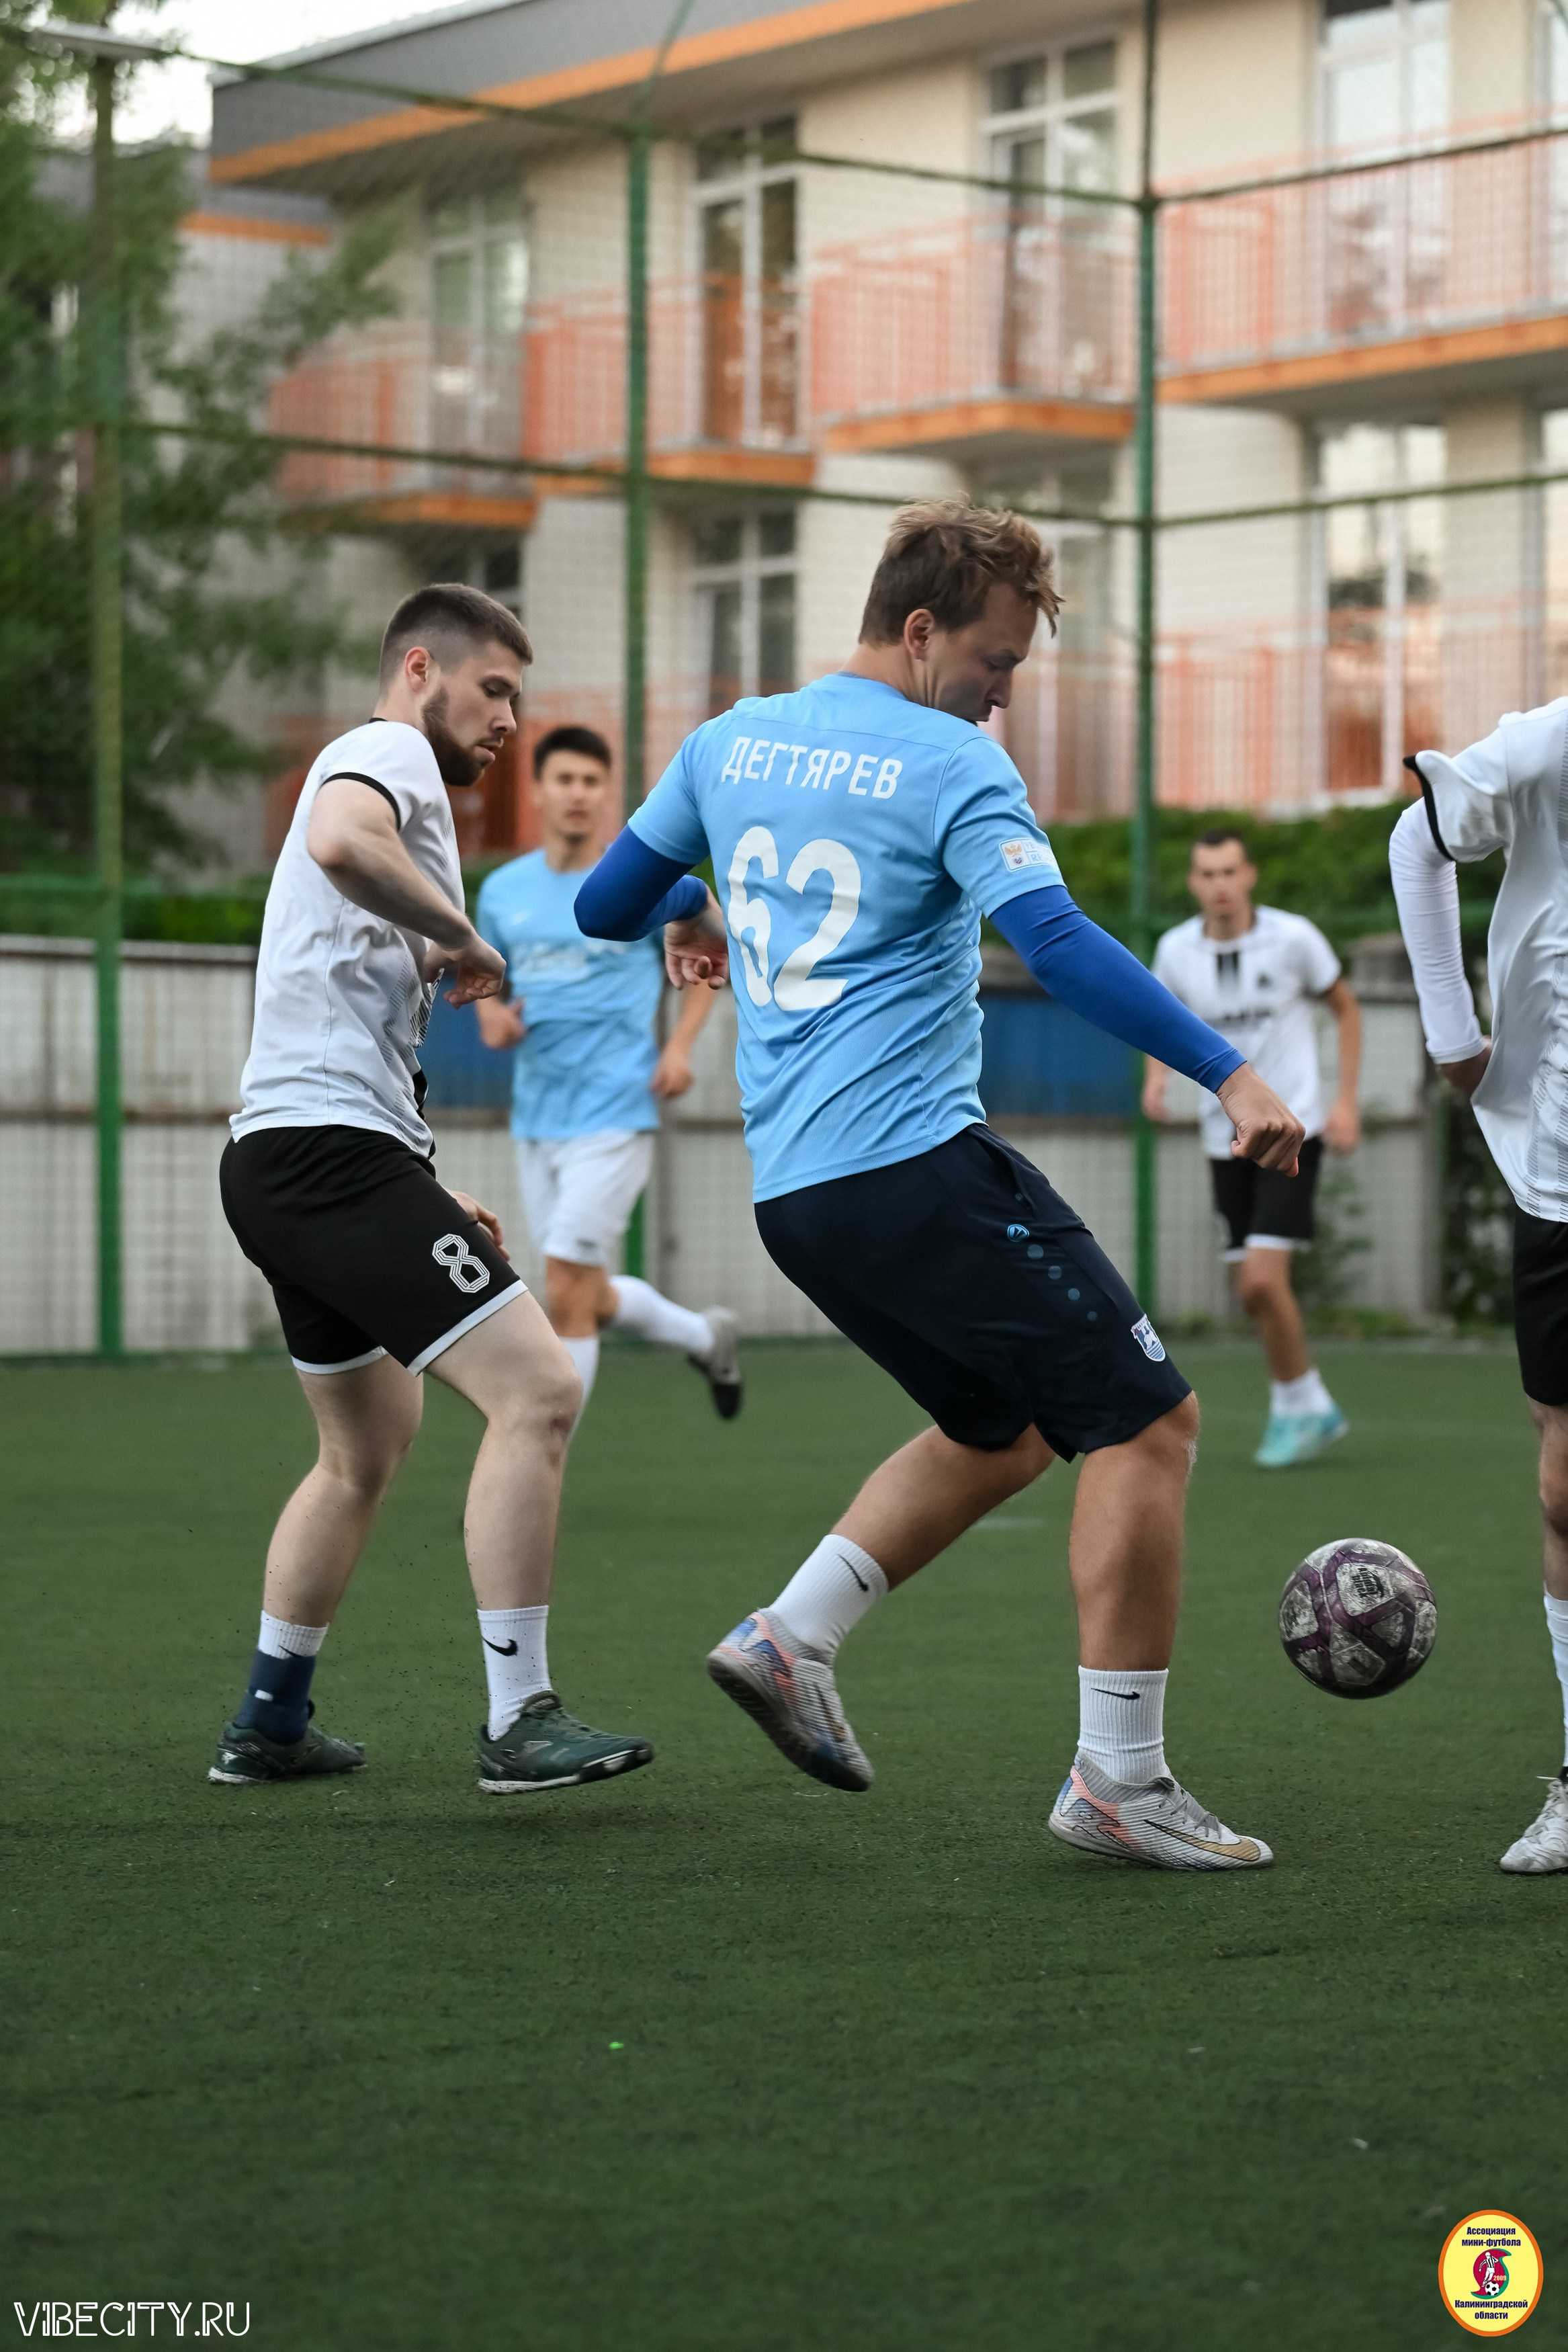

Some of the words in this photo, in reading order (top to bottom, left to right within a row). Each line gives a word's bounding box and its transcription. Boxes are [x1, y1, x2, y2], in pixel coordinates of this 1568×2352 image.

[721, 737, 903, 799] ДЕГТЯРЕВ
[728, 826, 861, 1011] 62
[432, 1233, 490, 1294] 8
